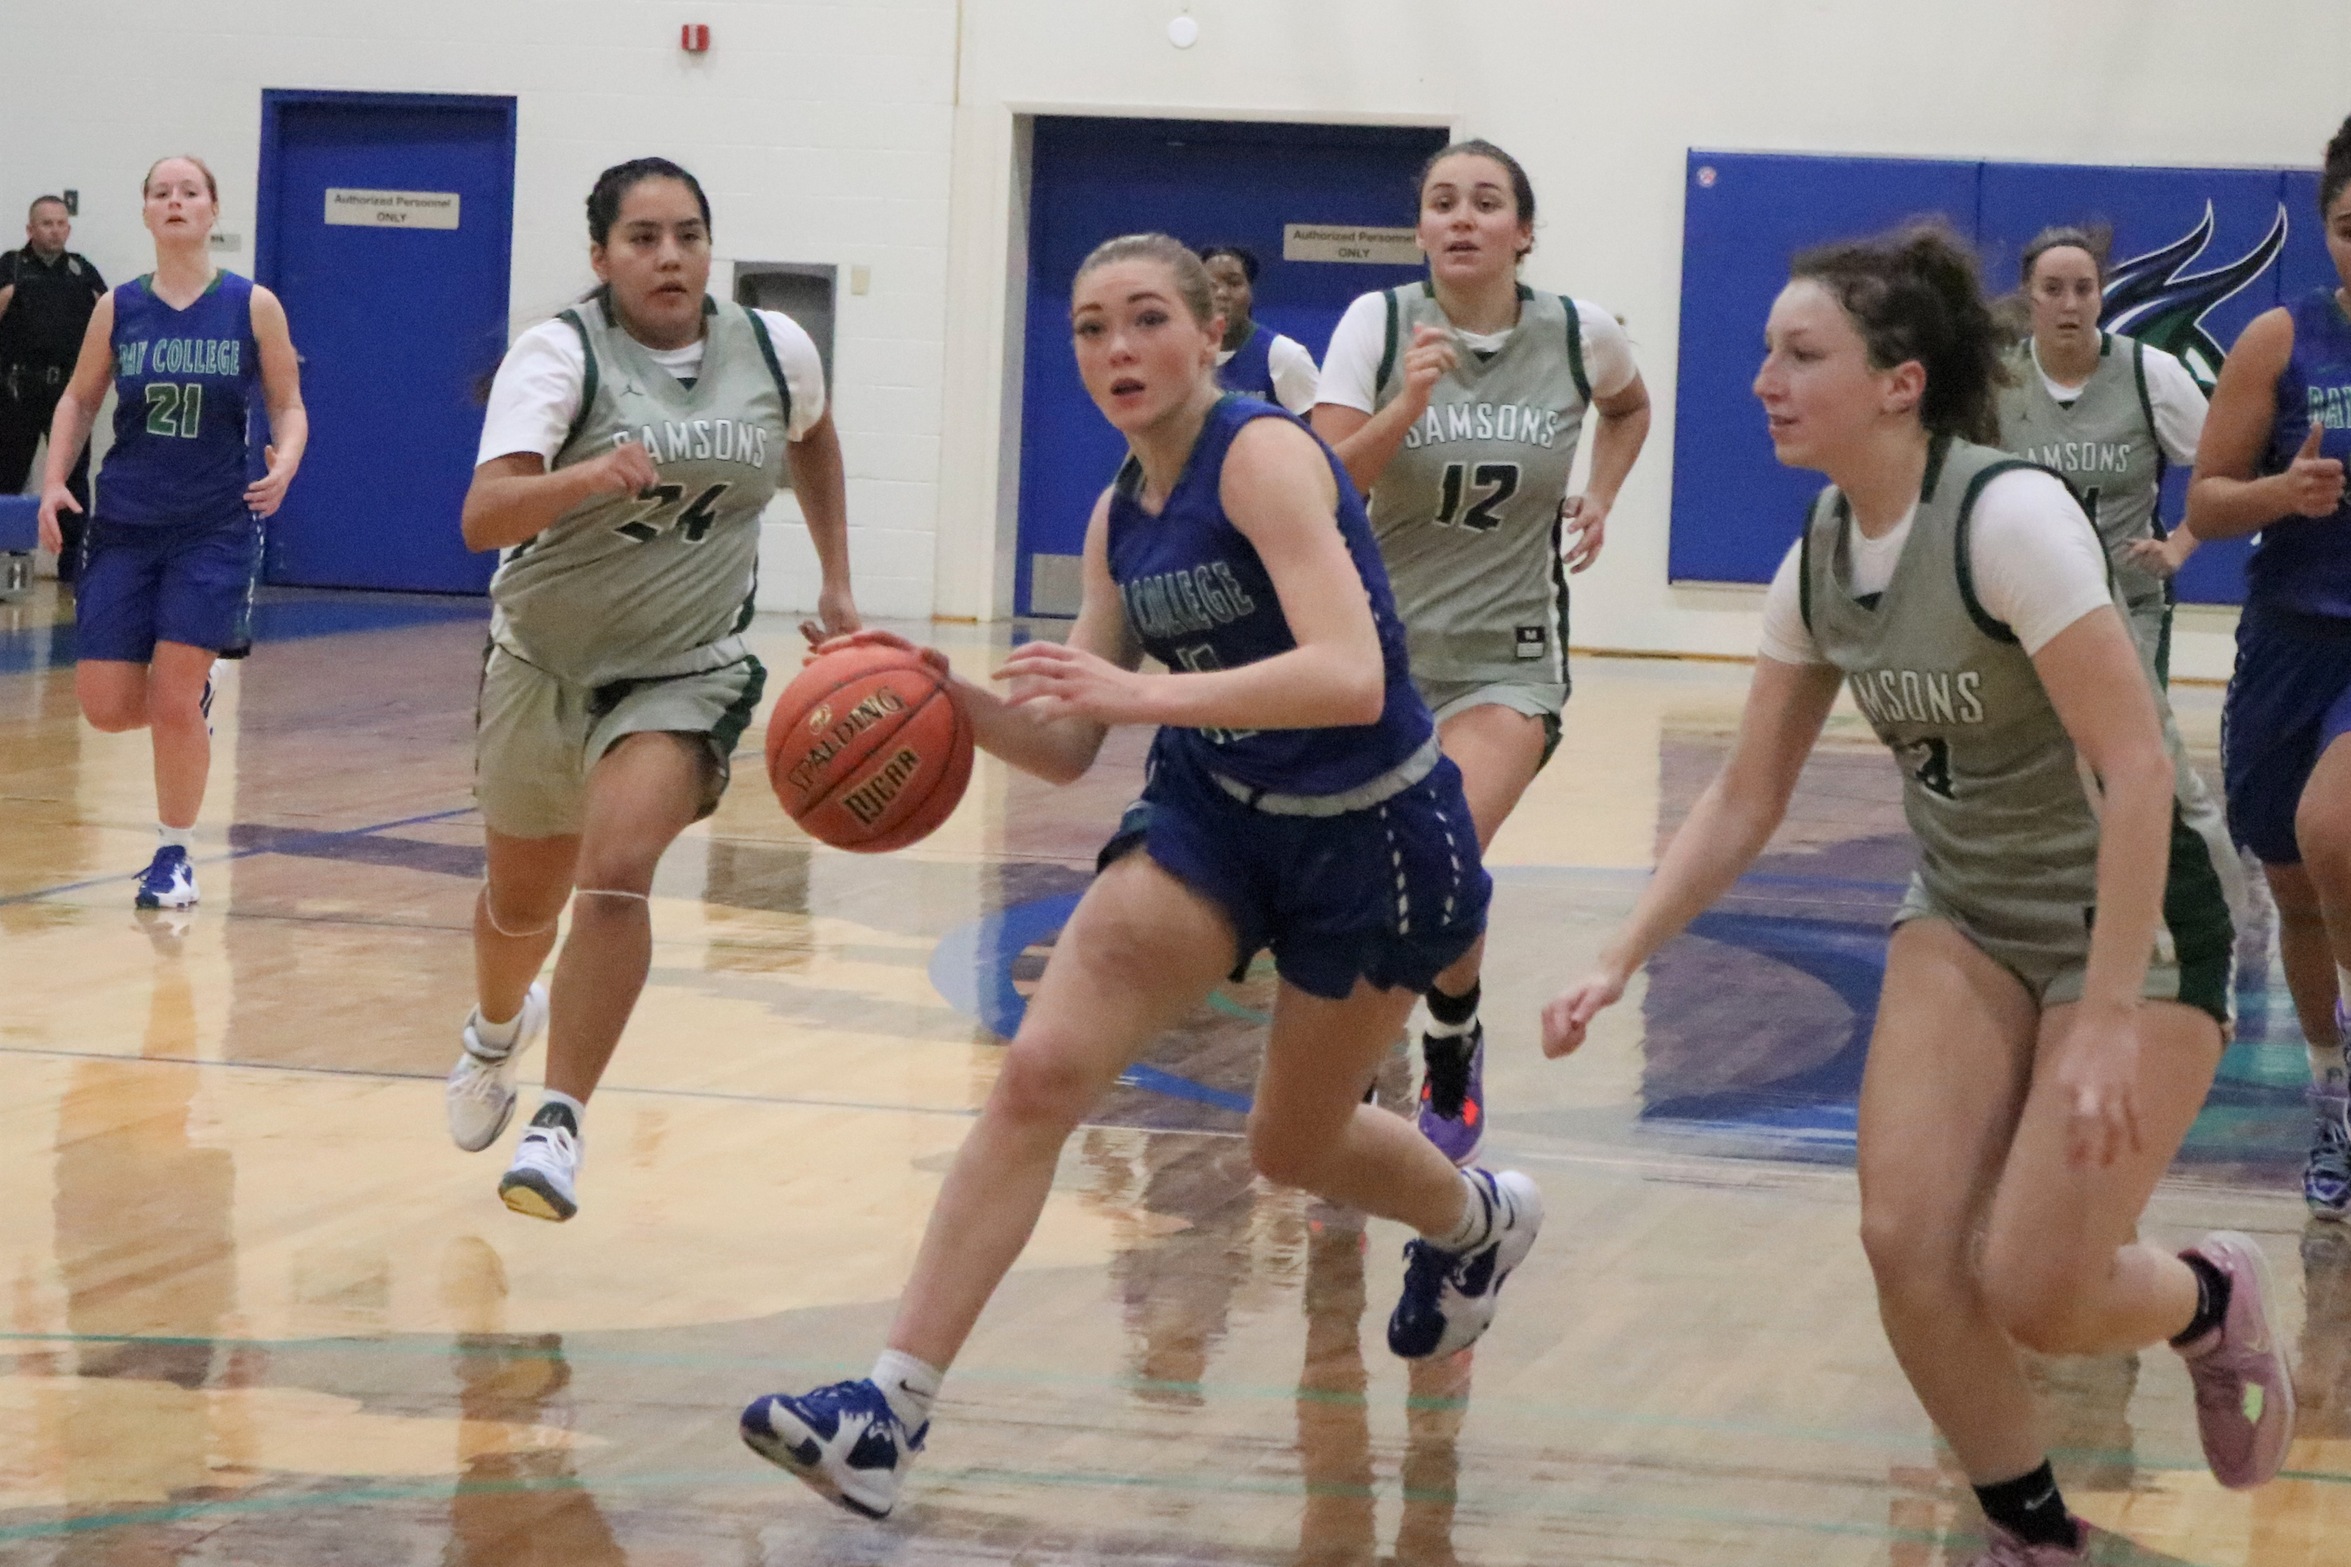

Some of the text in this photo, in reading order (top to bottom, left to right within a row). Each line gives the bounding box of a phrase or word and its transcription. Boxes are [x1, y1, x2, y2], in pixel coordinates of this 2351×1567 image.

[334, 194, 451, 208] Authorized Personnel
[376, 212, 407, 223] ONLY
[1293, 230, 1356, 241] Authorized
[1338, 248, 1370, 259] ONLY
[152, 338, 240, 376] COLLEGE
[145, 382, 202, 438] 21
[2012, 441, 2131, 473] AMSONS
[1431, 460, 1523, 533] 12
[1853, 670, 1984, 724] MSONS
[788, 685, 908, 794] SPALDING
